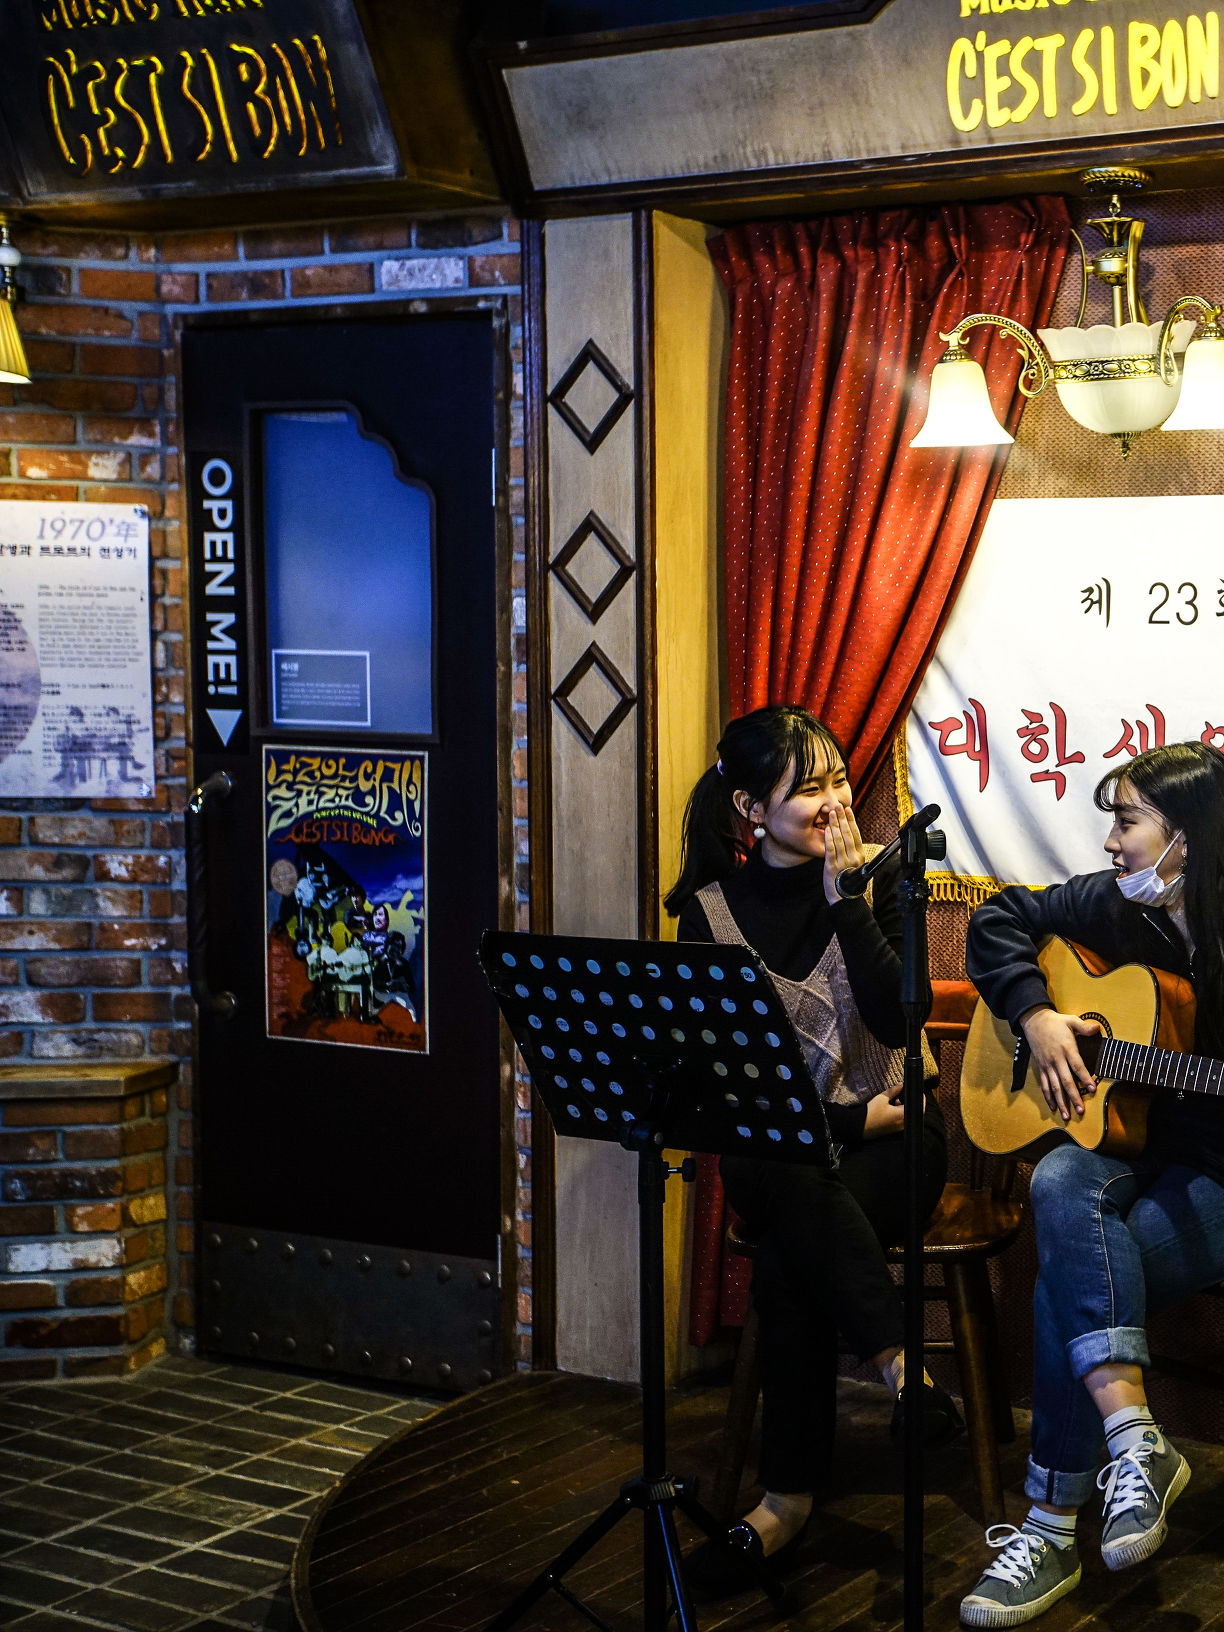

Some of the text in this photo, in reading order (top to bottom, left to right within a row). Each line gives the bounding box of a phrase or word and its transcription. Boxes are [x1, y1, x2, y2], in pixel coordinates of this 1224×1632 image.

[178, 48, 239, 163] SI
[946, 11, 1220, 132] C'EST SI BON
[201, 457, 238, 696] OPEN ME!
[1080, 576, 1112, 629] 제
